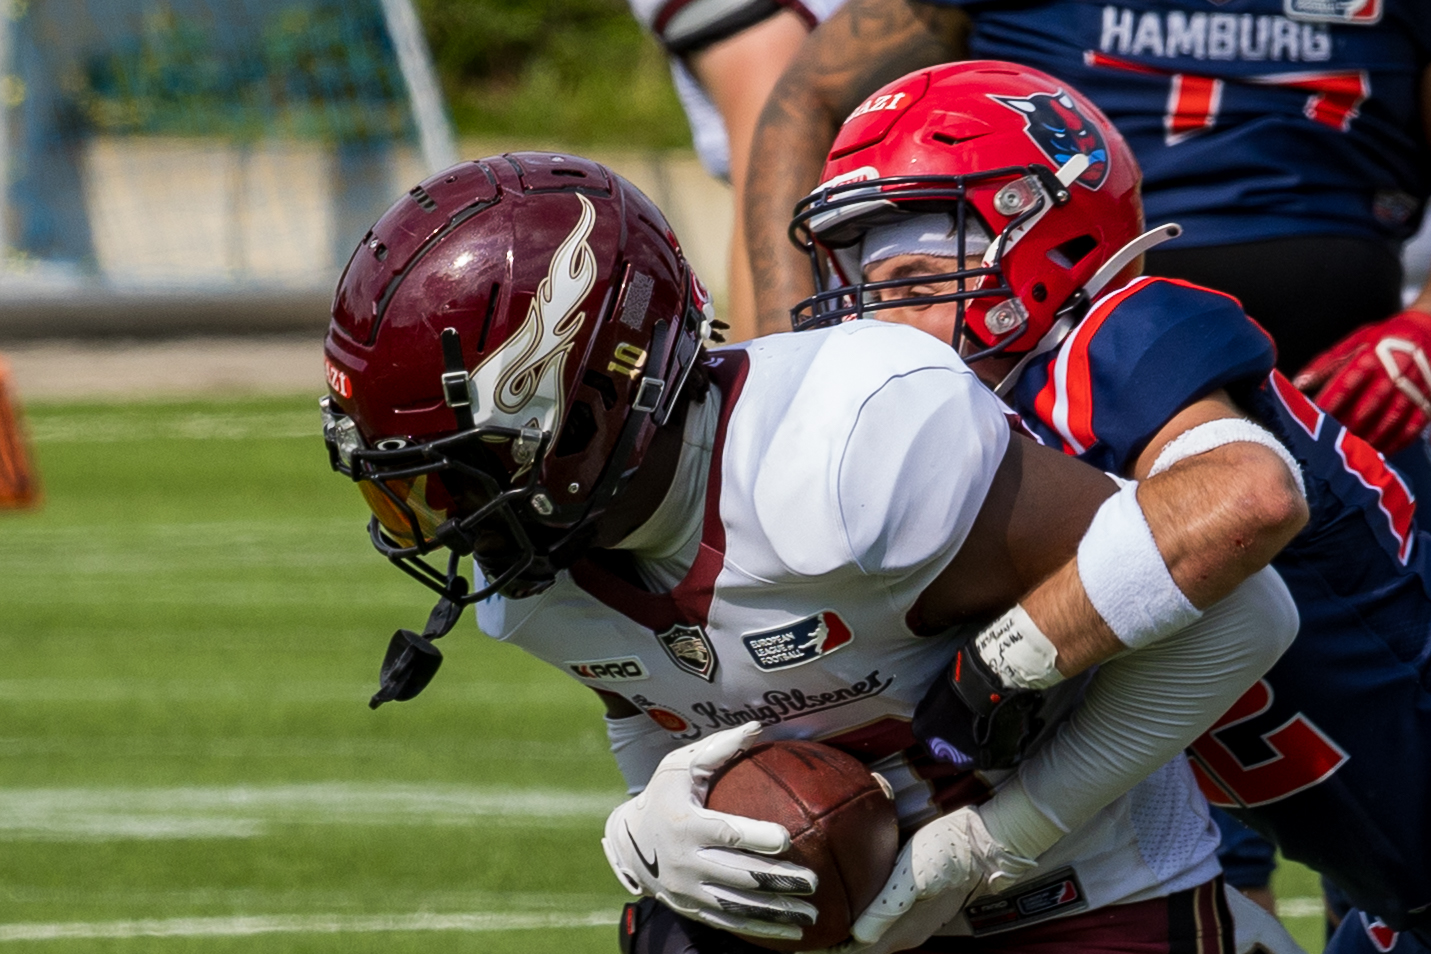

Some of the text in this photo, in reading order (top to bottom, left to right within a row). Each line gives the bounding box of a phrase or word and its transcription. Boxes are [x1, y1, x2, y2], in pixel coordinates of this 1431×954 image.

[1101, 6, 1331, 61] HAMBURG
[607, 342, 647, 380] 10
[749, 631, 796, 648] EUROPEAN
[754, 644, 788, 657] LEAGUE
[761, 649, 805, 665] FOOTBALL
